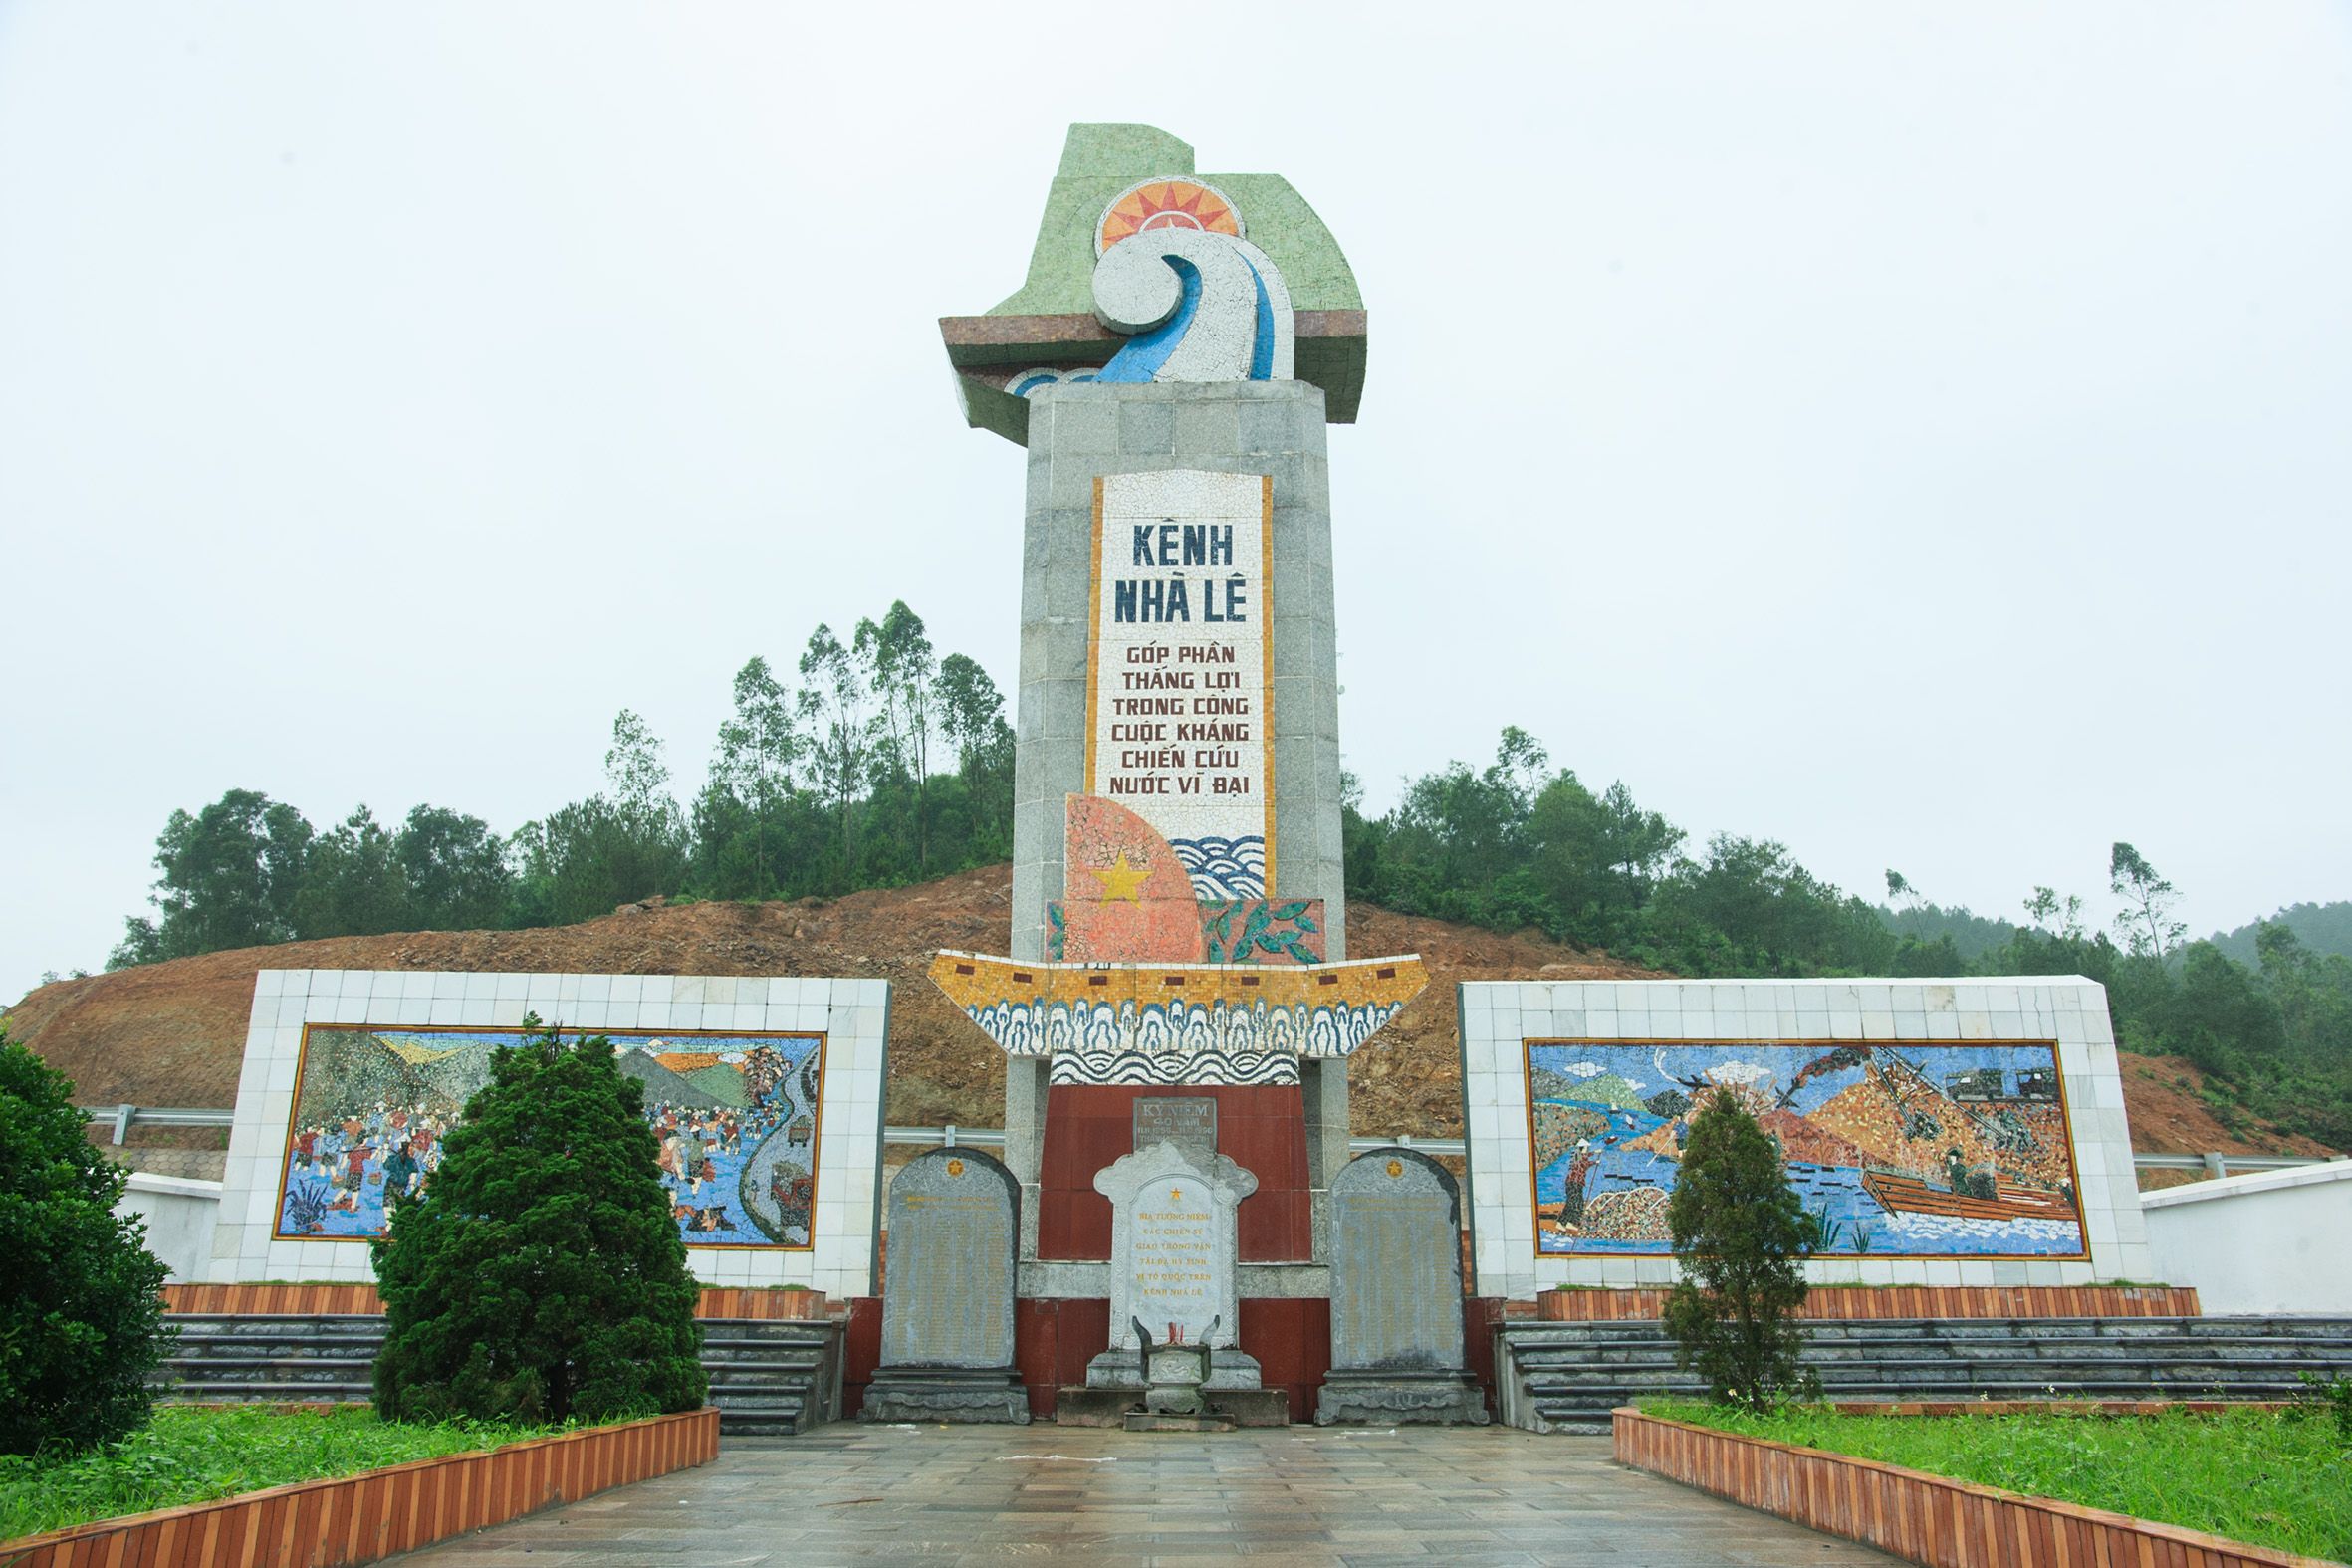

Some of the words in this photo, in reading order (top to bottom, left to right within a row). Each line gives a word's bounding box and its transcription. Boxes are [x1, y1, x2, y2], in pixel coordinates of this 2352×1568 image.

[1133, 518, 1232, 565] KÊNH
[1115, 571, 1190, 622] NHÀ
[1204, 572, 1246, 622] LÊ
[1127, 640, 1169, 663] GÓP
[1179, 640, 1235, 663] PHẦN
[1122, 665, 1194, 689] THẮNG
[1205, 672, 1240, 692] LỢI
[1112, 698, 1184, 715] TRONG
[1194, 694, 1249, 715] CÔNG
[1111, 720, 1167, 745] CUỘC
[1177, 718, 1249, 741] KHÁNG
[1122, 744, 1186, 768] CHIẾN
[1195, 745, 1239, 768] CỨU
[1109, 771, 1170, 794] NƯỚC
[1178, 772, 1204, 794] VĨ
[1212, 777, 1249, 797] ĐẠI
